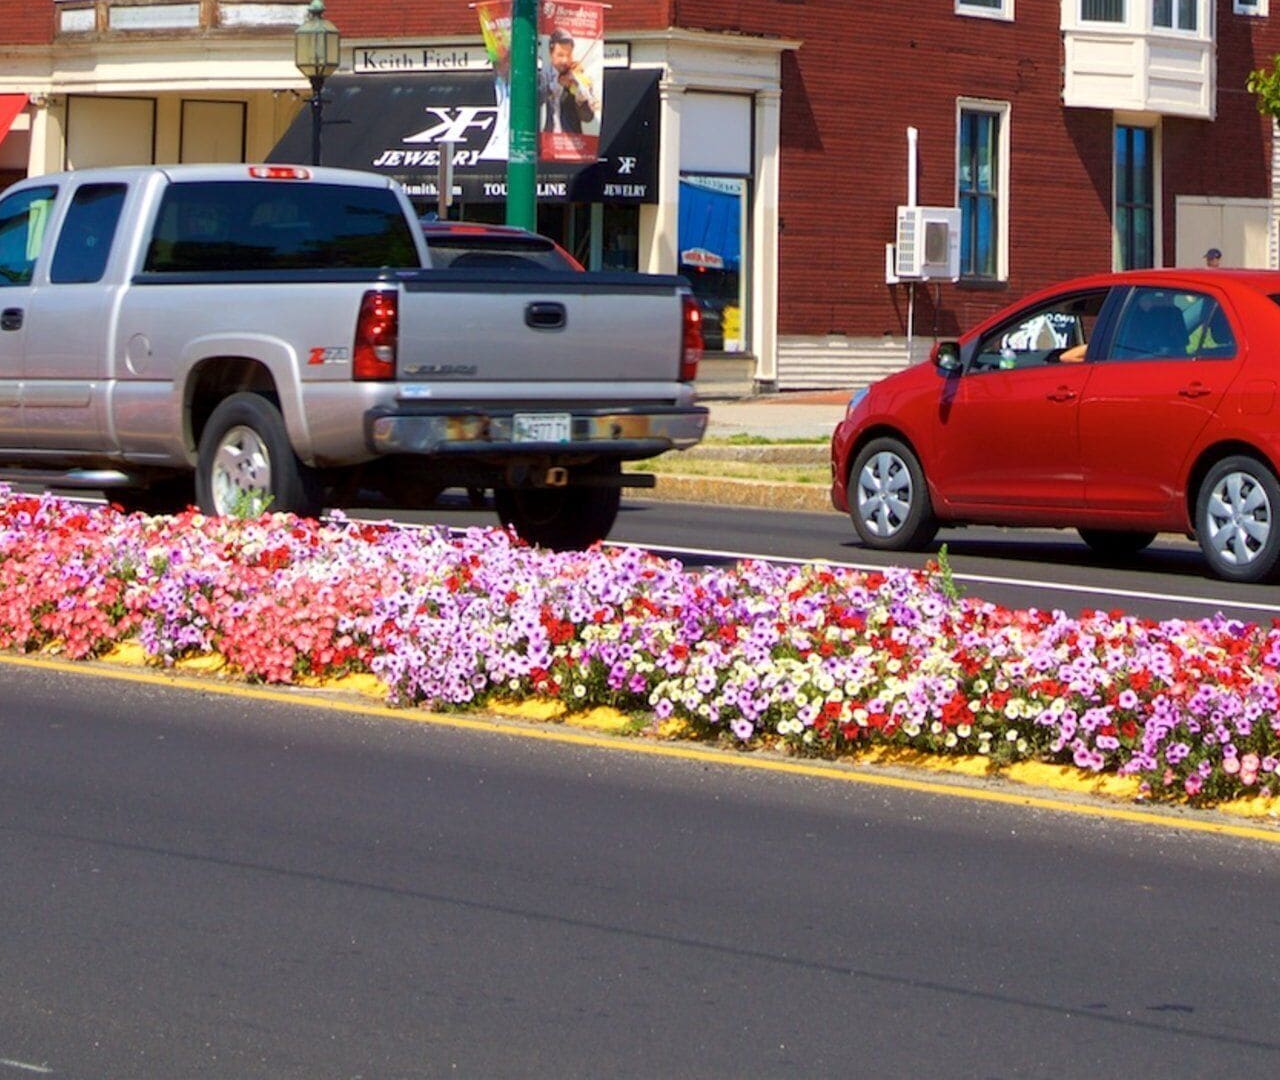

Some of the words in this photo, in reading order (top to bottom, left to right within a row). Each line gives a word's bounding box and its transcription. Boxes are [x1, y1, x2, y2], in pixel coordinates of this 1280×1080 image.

[363, 51, 414, 69] Keith
[422, 49, 469, 68] Field
[373, 150, 480, 166] JEWERY
[483, 184, 567, 196] TOULINE
[604, 184, 647, 197] JEWELRY
